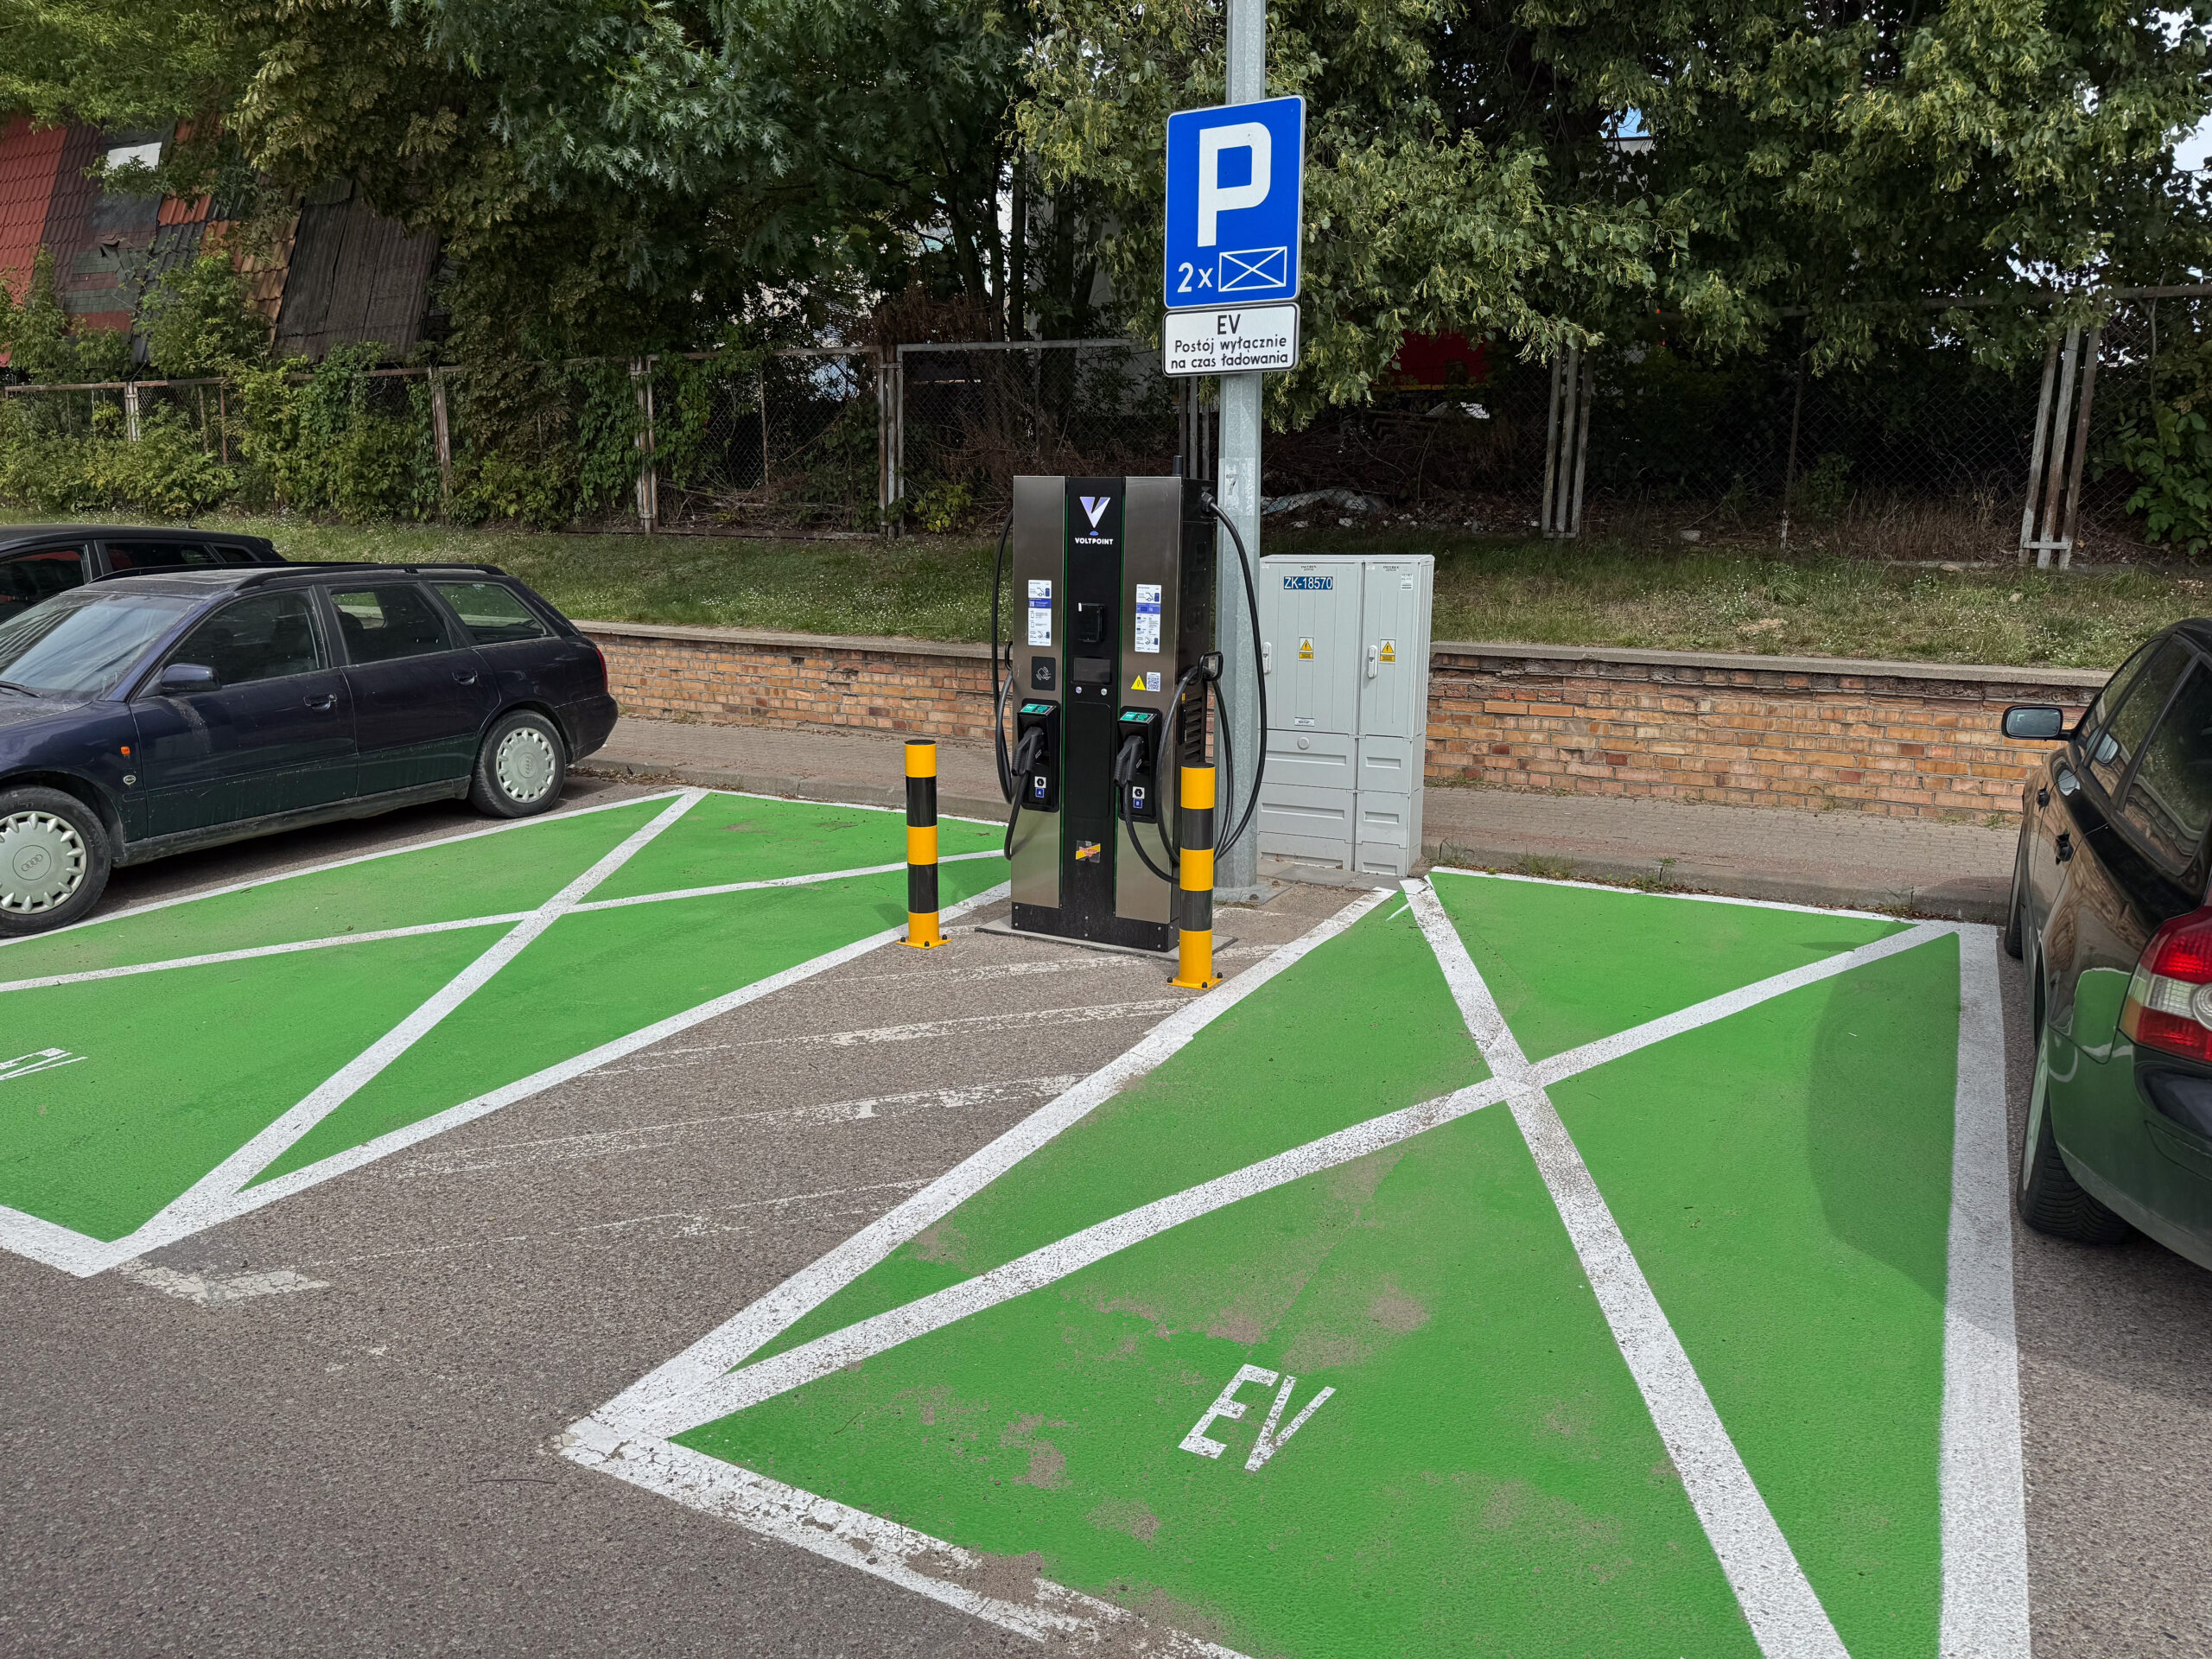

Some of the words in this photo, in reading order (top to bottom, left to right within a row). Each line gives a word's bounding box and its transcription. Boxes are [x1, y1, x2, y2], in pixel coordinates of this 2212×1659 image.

[1198, 122, 1272, 247] P
[1217, 314, 1241, 335] EV
[1174, 338, 1215, 354] Postój
[1220, 334, 1287, 353] wyłącznie
[1171, 359, 1186, 369] na
[1191, 358, 1217, 368] czas
[1221, 350, 1288, 366] ładowania
[1284, 576, 1333, 589] ZK-18570
[1178, 1363, 1337, 1471] EV
